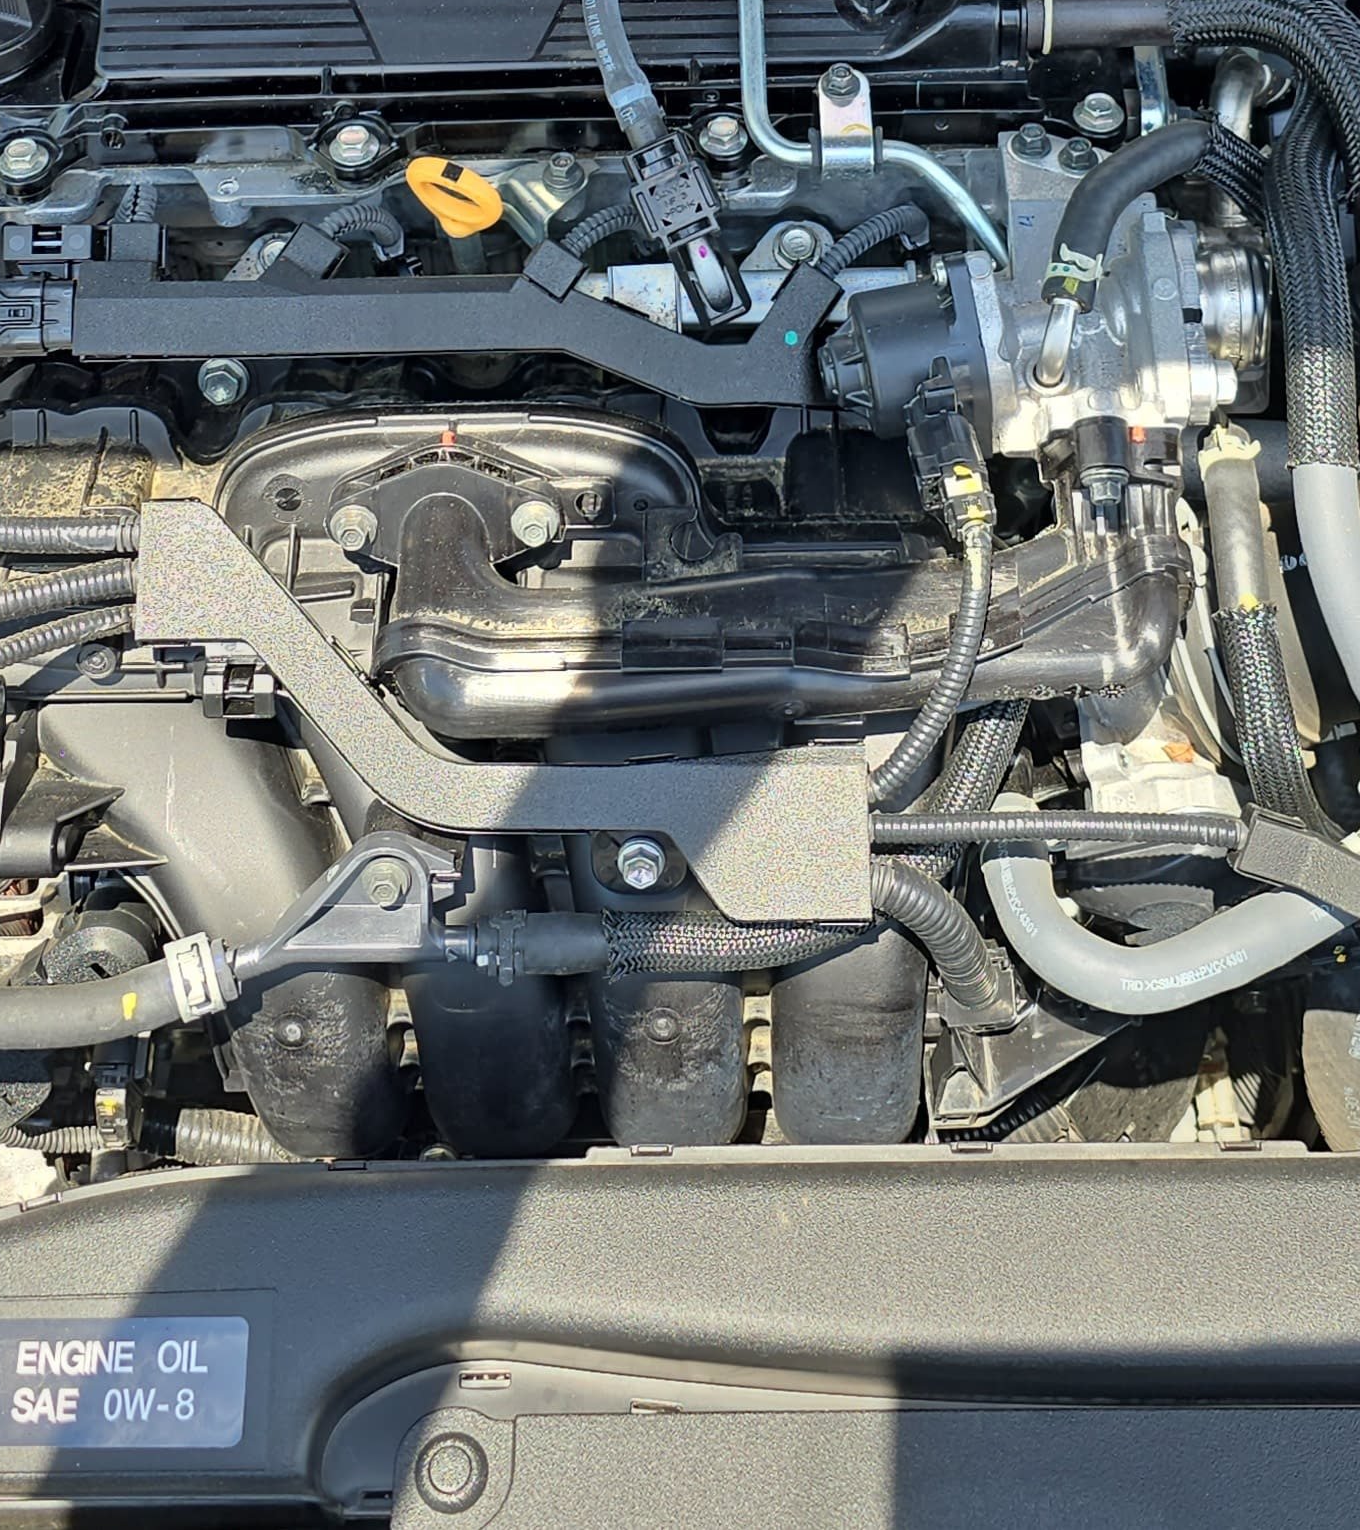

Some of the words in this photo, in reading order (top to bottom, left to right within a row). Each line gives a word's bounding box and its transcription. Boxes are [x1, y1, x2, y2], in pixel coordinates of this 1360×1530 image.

[15, 1339, 136, 1376] ENGINE
[157, 1339, 209, 1374] OIL
[10, 1387, 80, 1423] SAE
[103, 1387, 195, 1422] 0W-8
